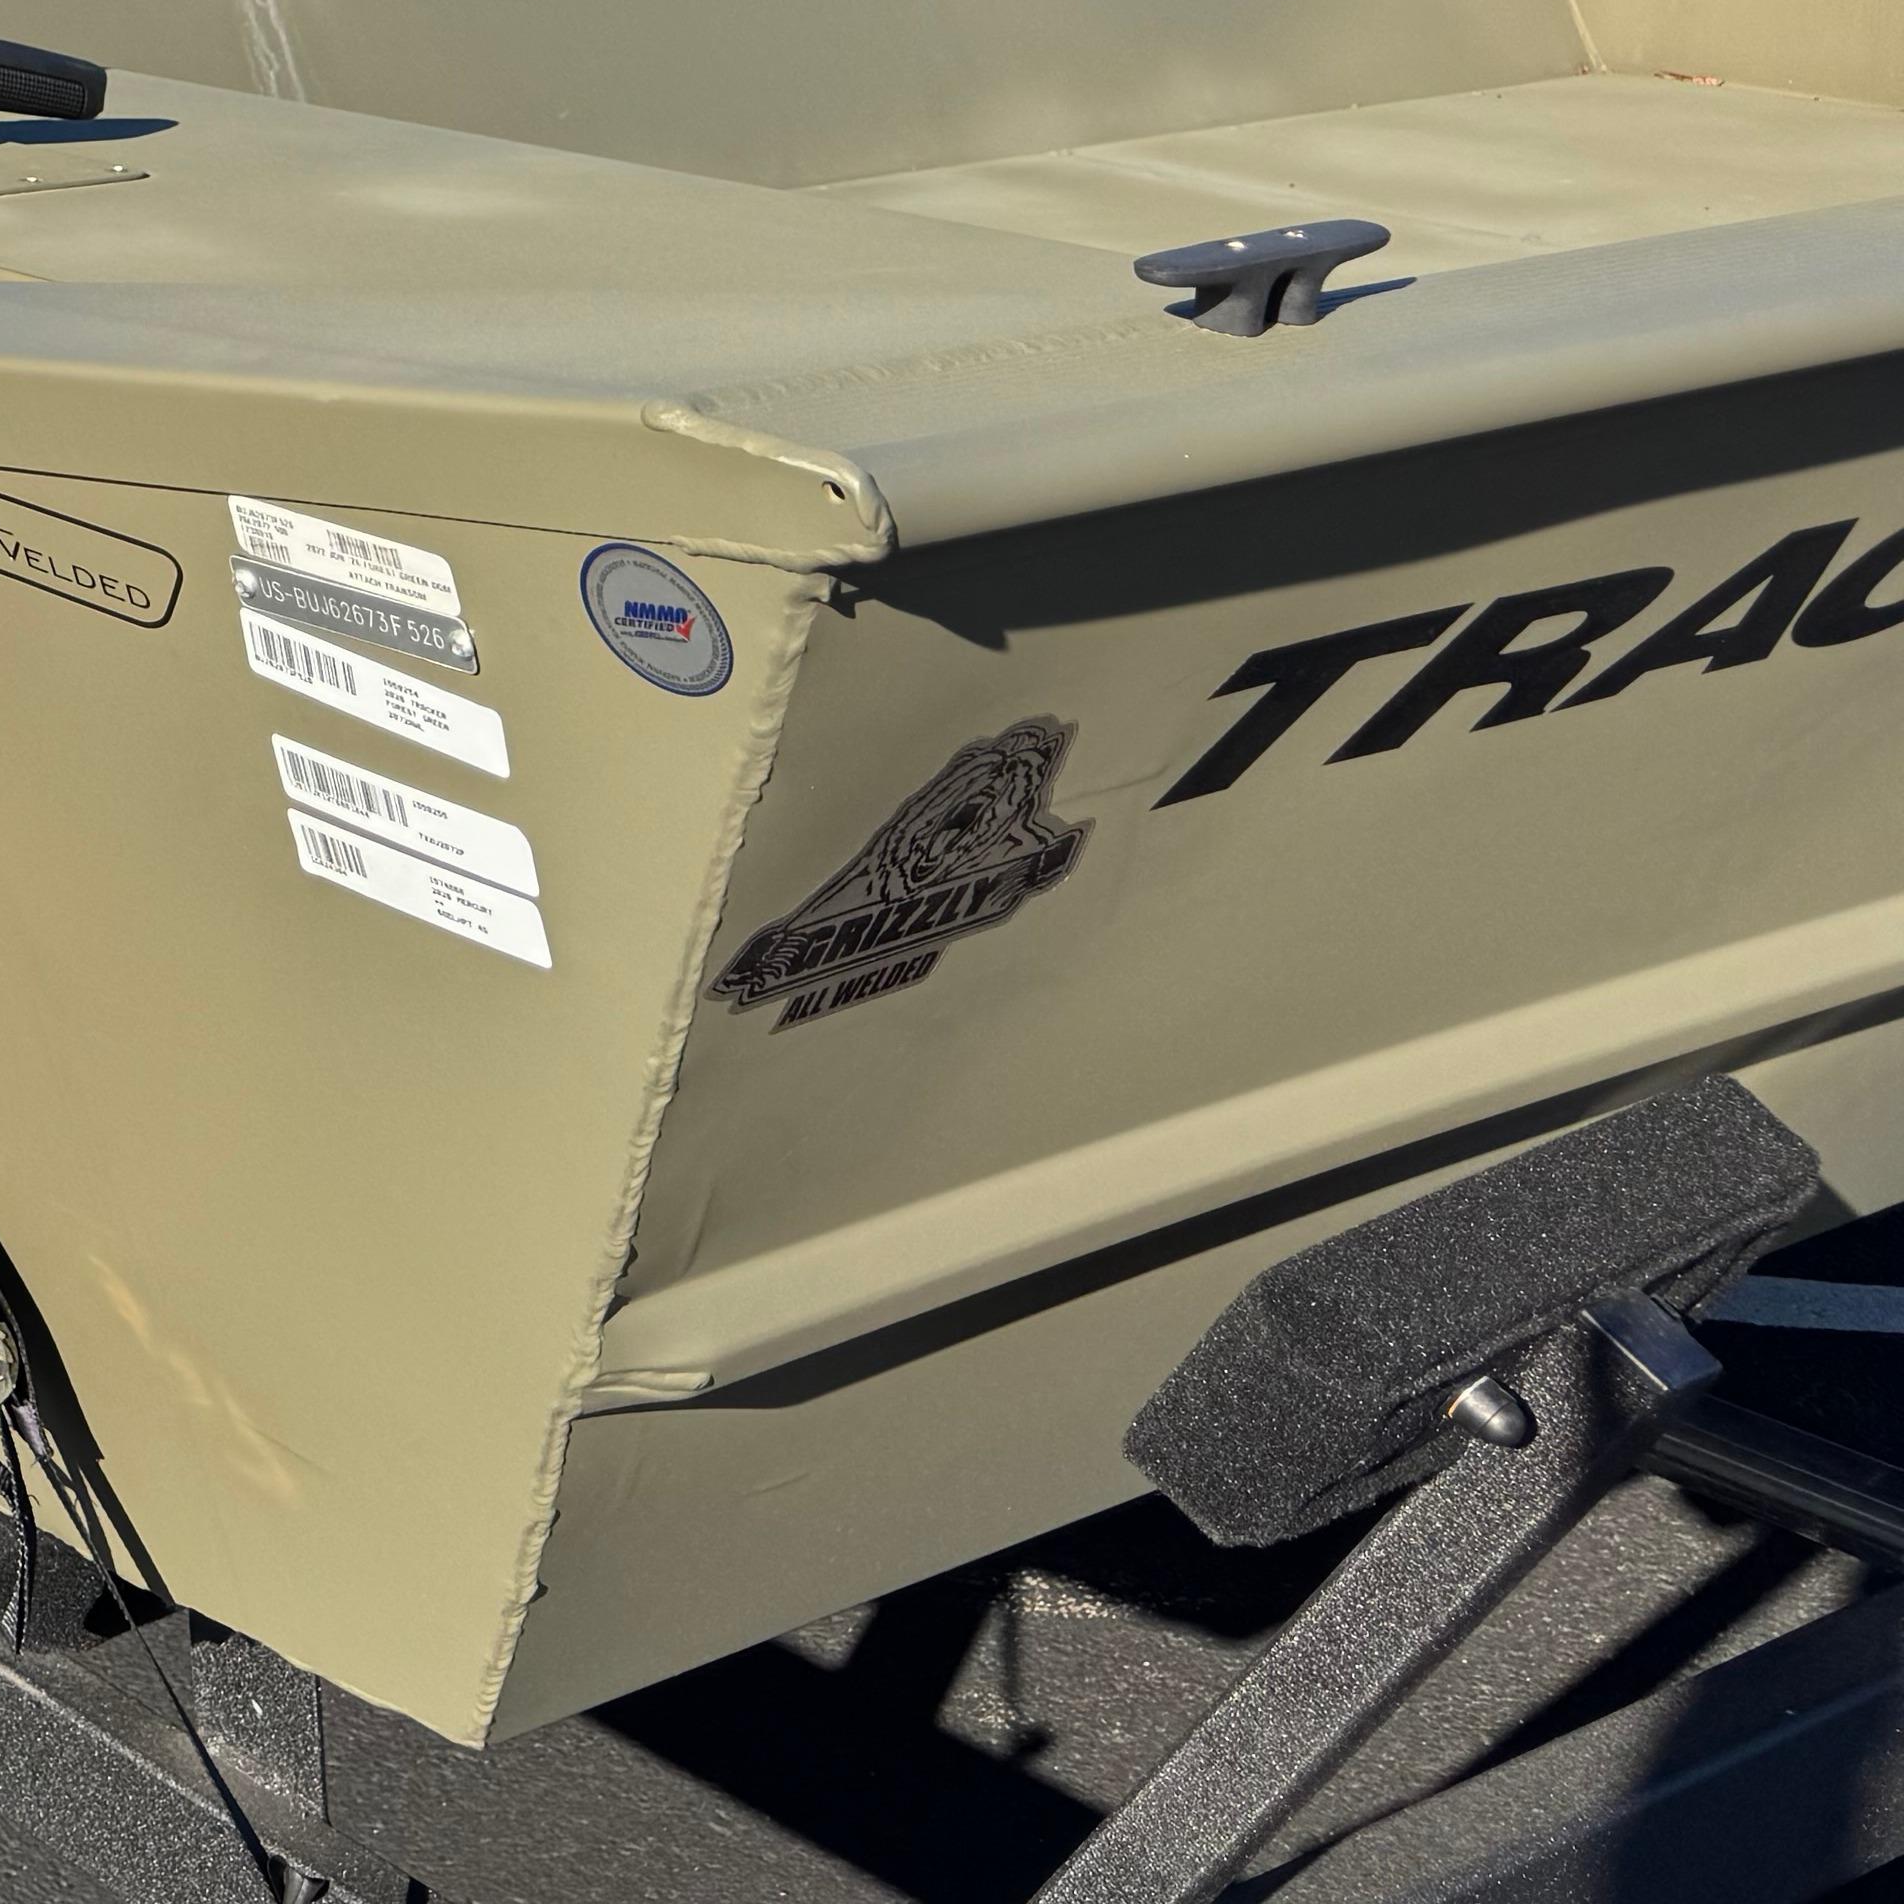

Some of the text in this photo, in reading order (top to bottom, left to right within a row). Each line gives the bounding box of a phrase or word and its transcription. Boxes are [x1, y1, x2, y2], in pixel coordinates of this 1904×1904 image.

[258, 576, 446, 650] US-BUJ62673F 526
[614, 616, 675, 633] CERTIFIED
[800, 874, 1007, 968] GRIZZLY
[778, 947, 942, 1029] ALL WELDED
